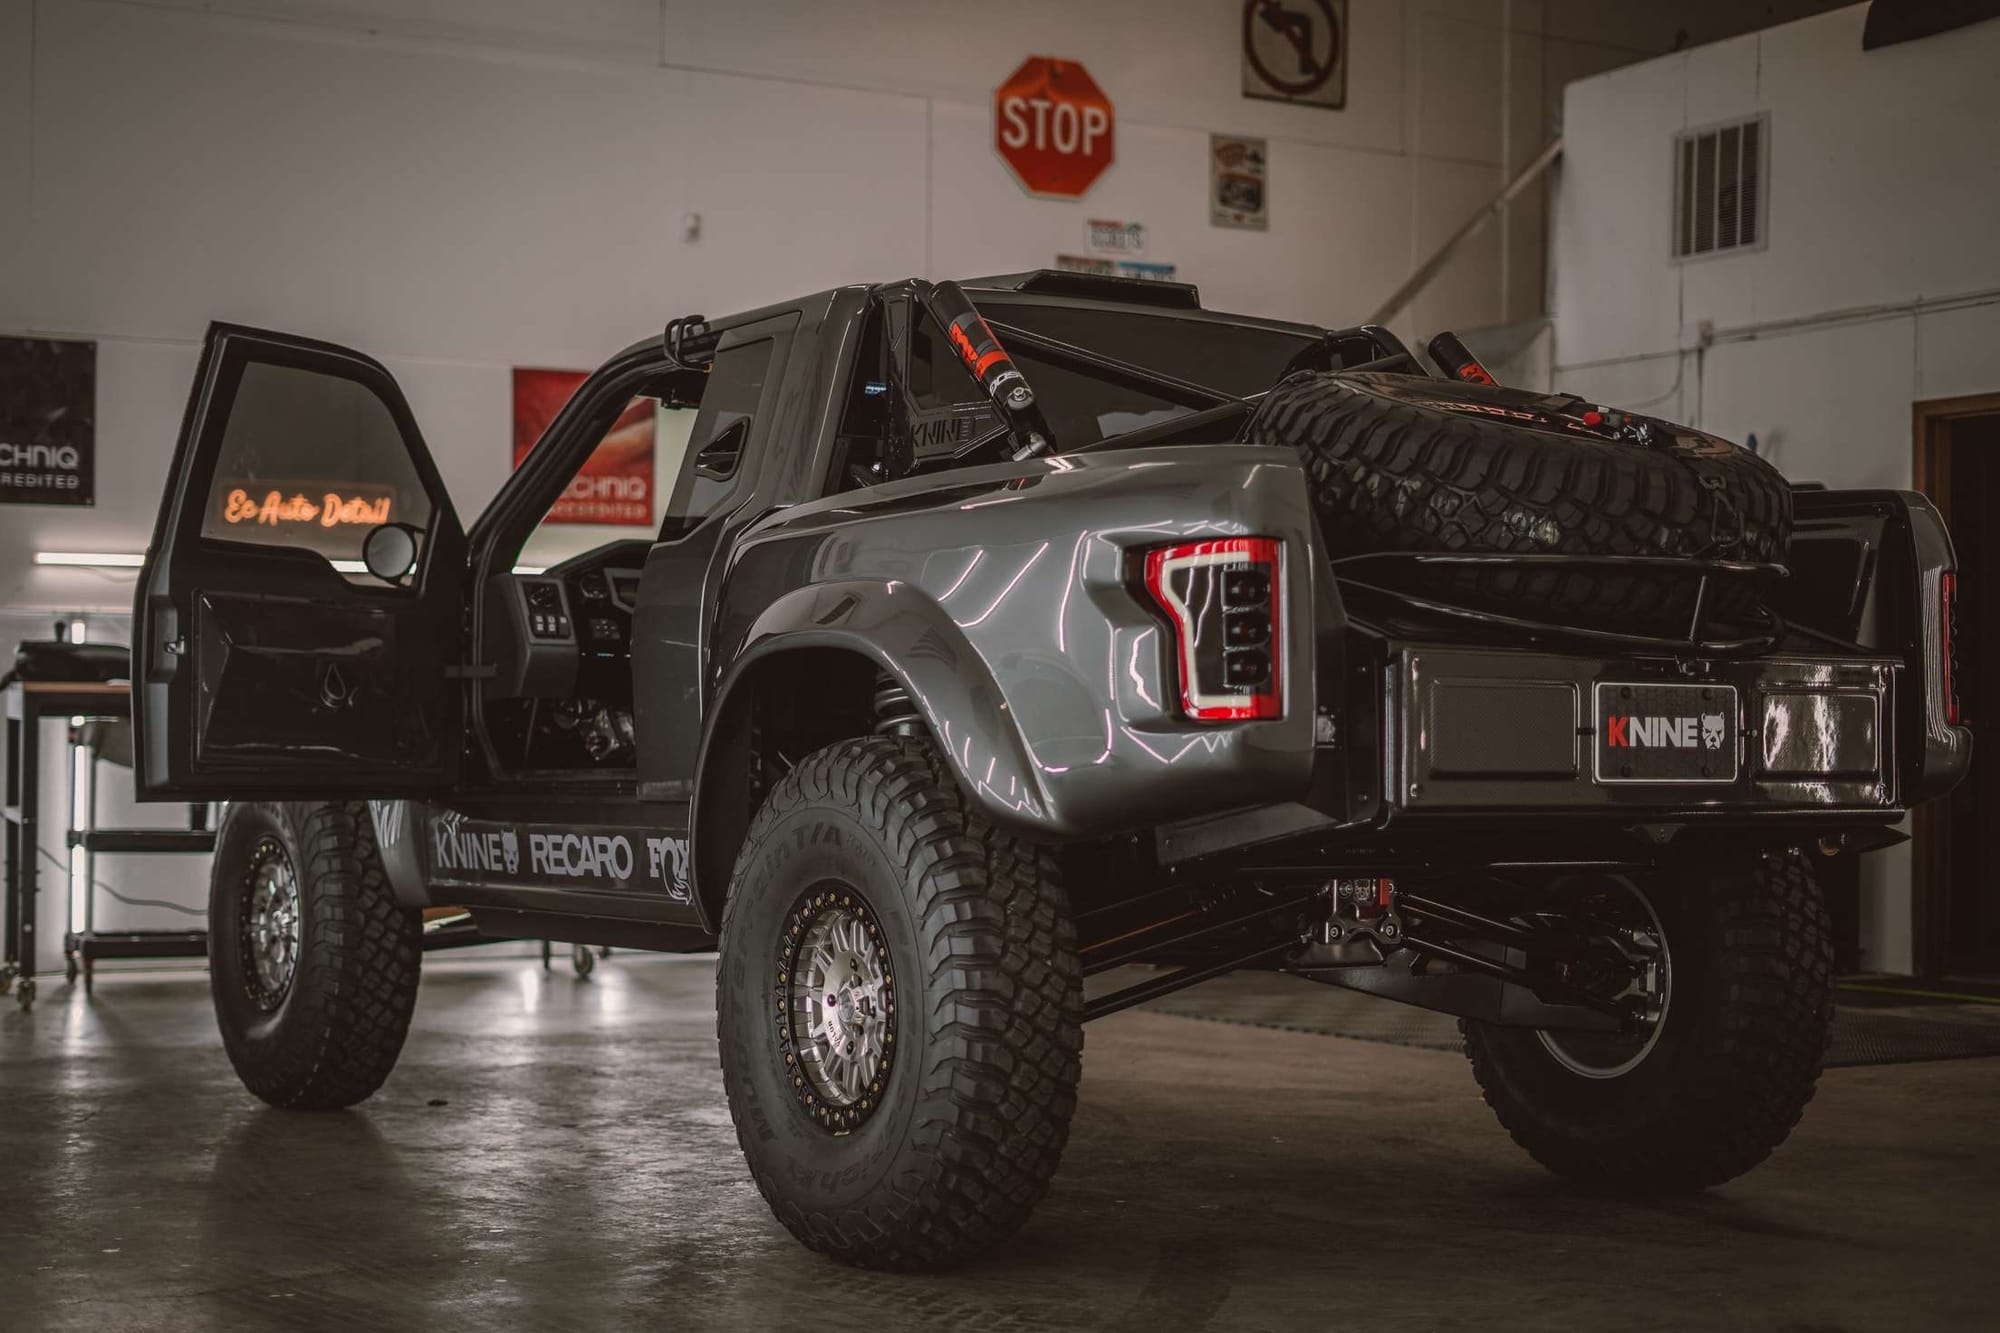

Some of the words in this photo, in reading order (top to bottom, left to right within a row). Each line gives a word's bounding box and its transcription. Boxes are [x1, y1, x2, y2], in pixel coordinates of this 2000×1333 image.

[1001, 96, 1109, 157] STOP
[258, 490, 320, 526] Auto
[320, 493, 392, 528] Detail
[1608, 714, 1698, 748] KNINE
[436, 831, 503, 872] KNINE
[528, 833, 634, 880] RECARO
